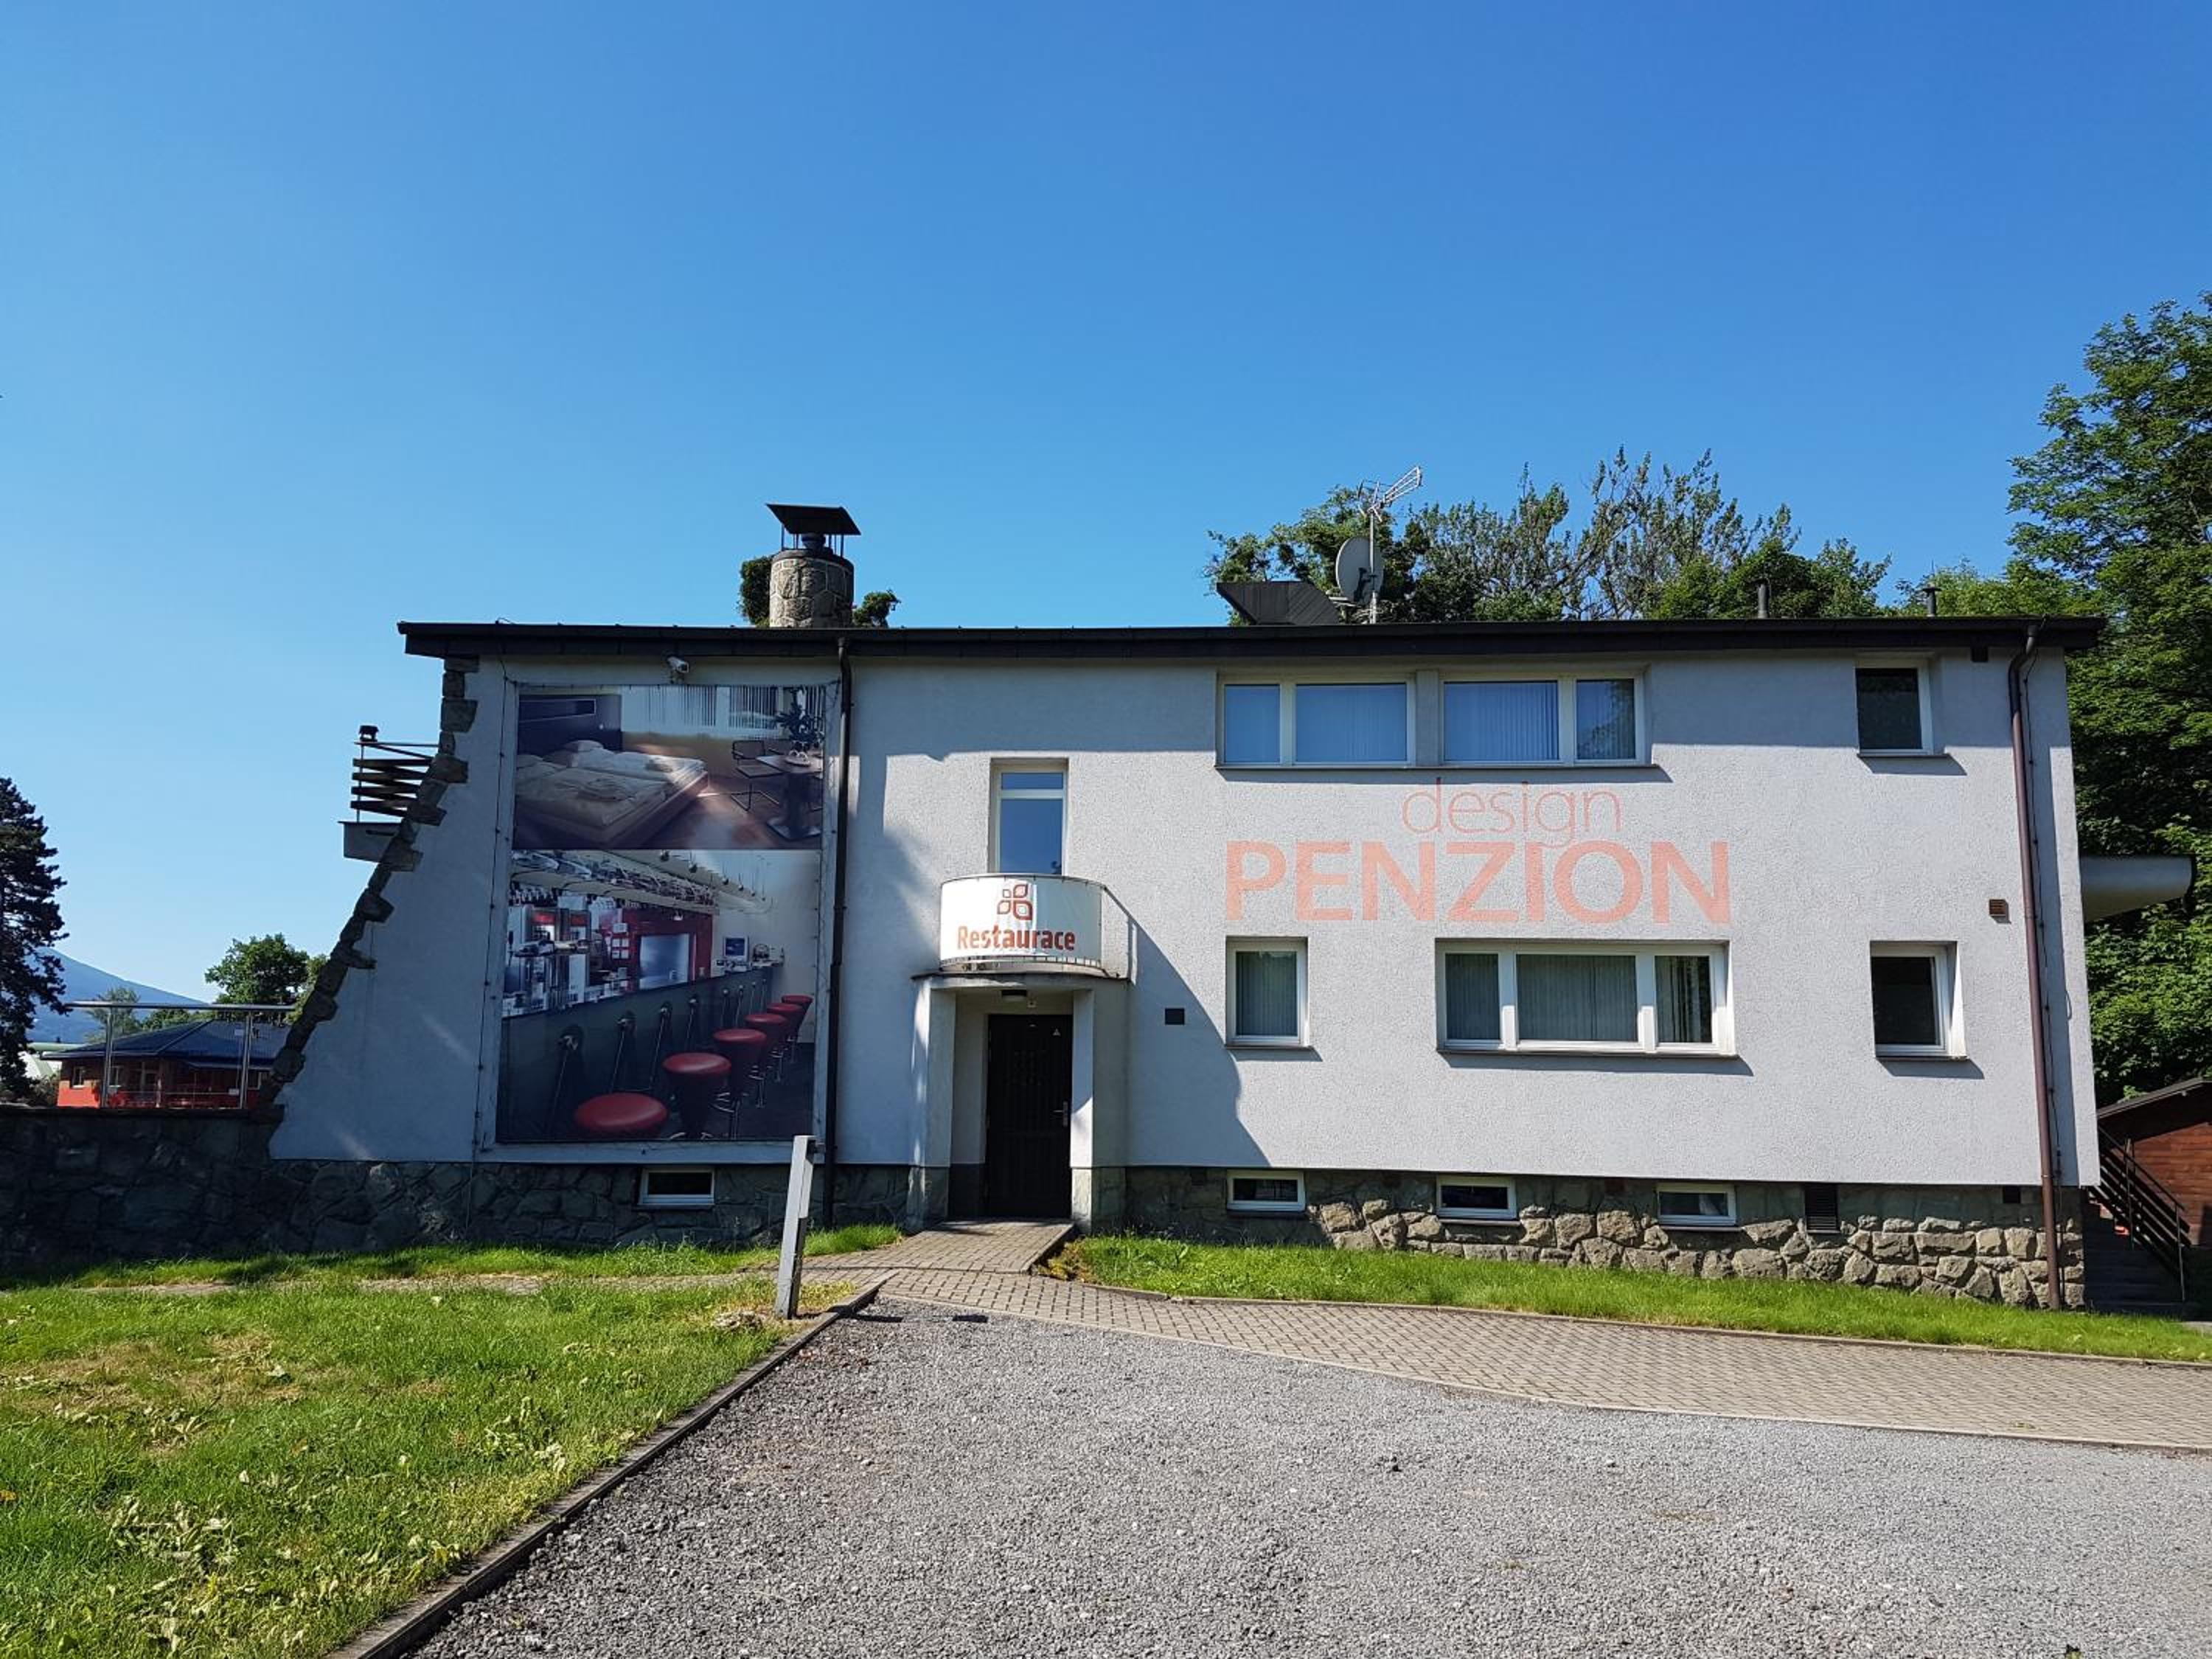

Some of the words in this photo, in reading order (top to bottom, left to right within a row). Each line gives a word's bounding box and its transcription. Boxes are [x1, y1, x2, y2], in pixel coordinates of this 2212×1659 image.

[1402, 777, 1621, 848] design
[1225, 840, 1731, 924] PENZION
[957, 925, 1075, 950] Restaurace
